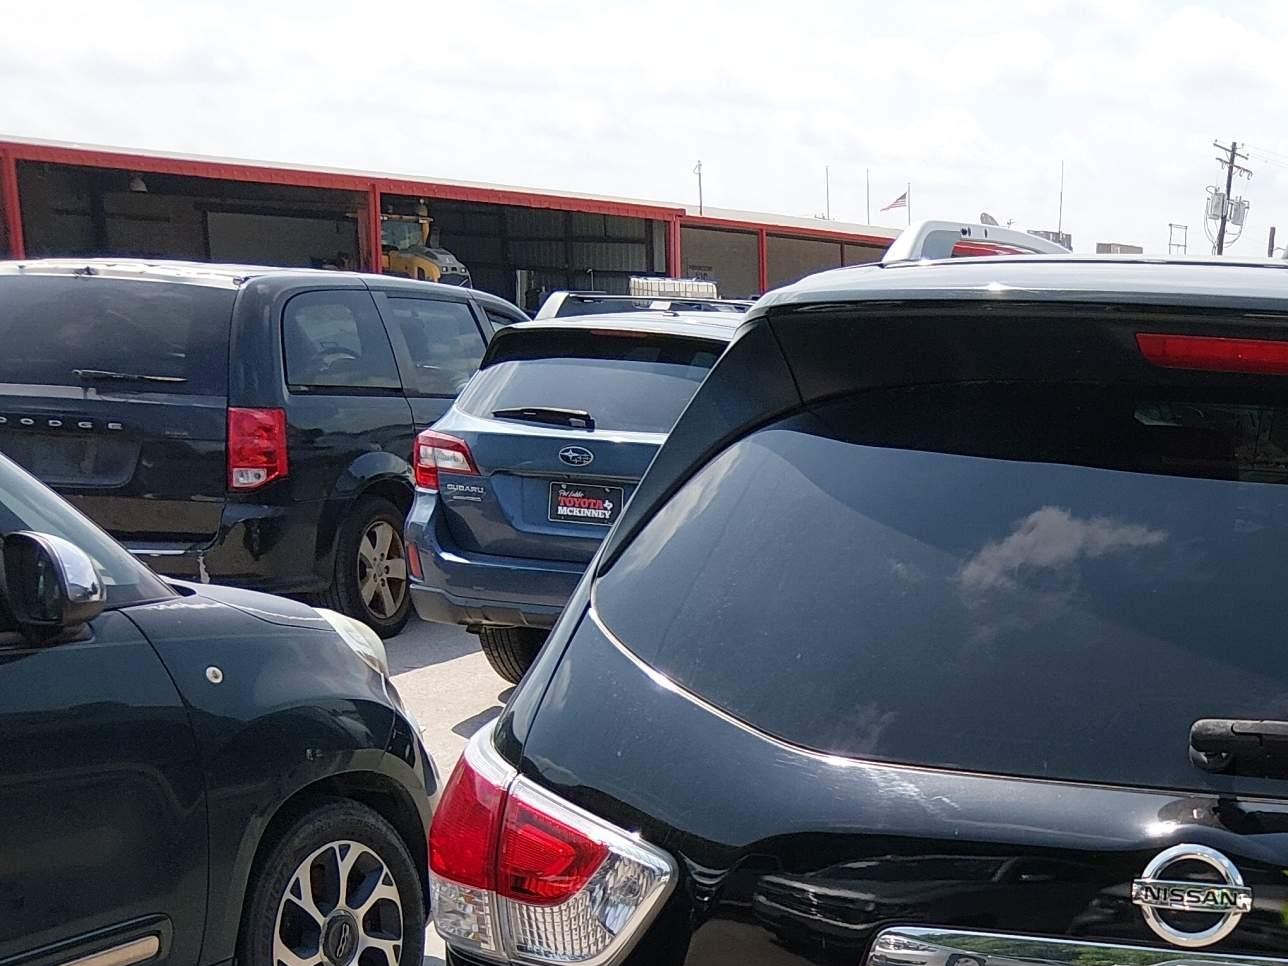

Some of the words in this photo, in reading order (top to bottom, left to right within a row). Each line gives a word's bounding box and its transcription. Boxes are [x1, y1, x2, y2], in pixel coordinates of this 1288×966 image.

[446, 483, 485, 494] SUBARU
[559, 496, 604, 509] TOYOTA
[557, 506, 612, 519] MCKINNEY
[1143, 886, 1238, 906] NISSAN
